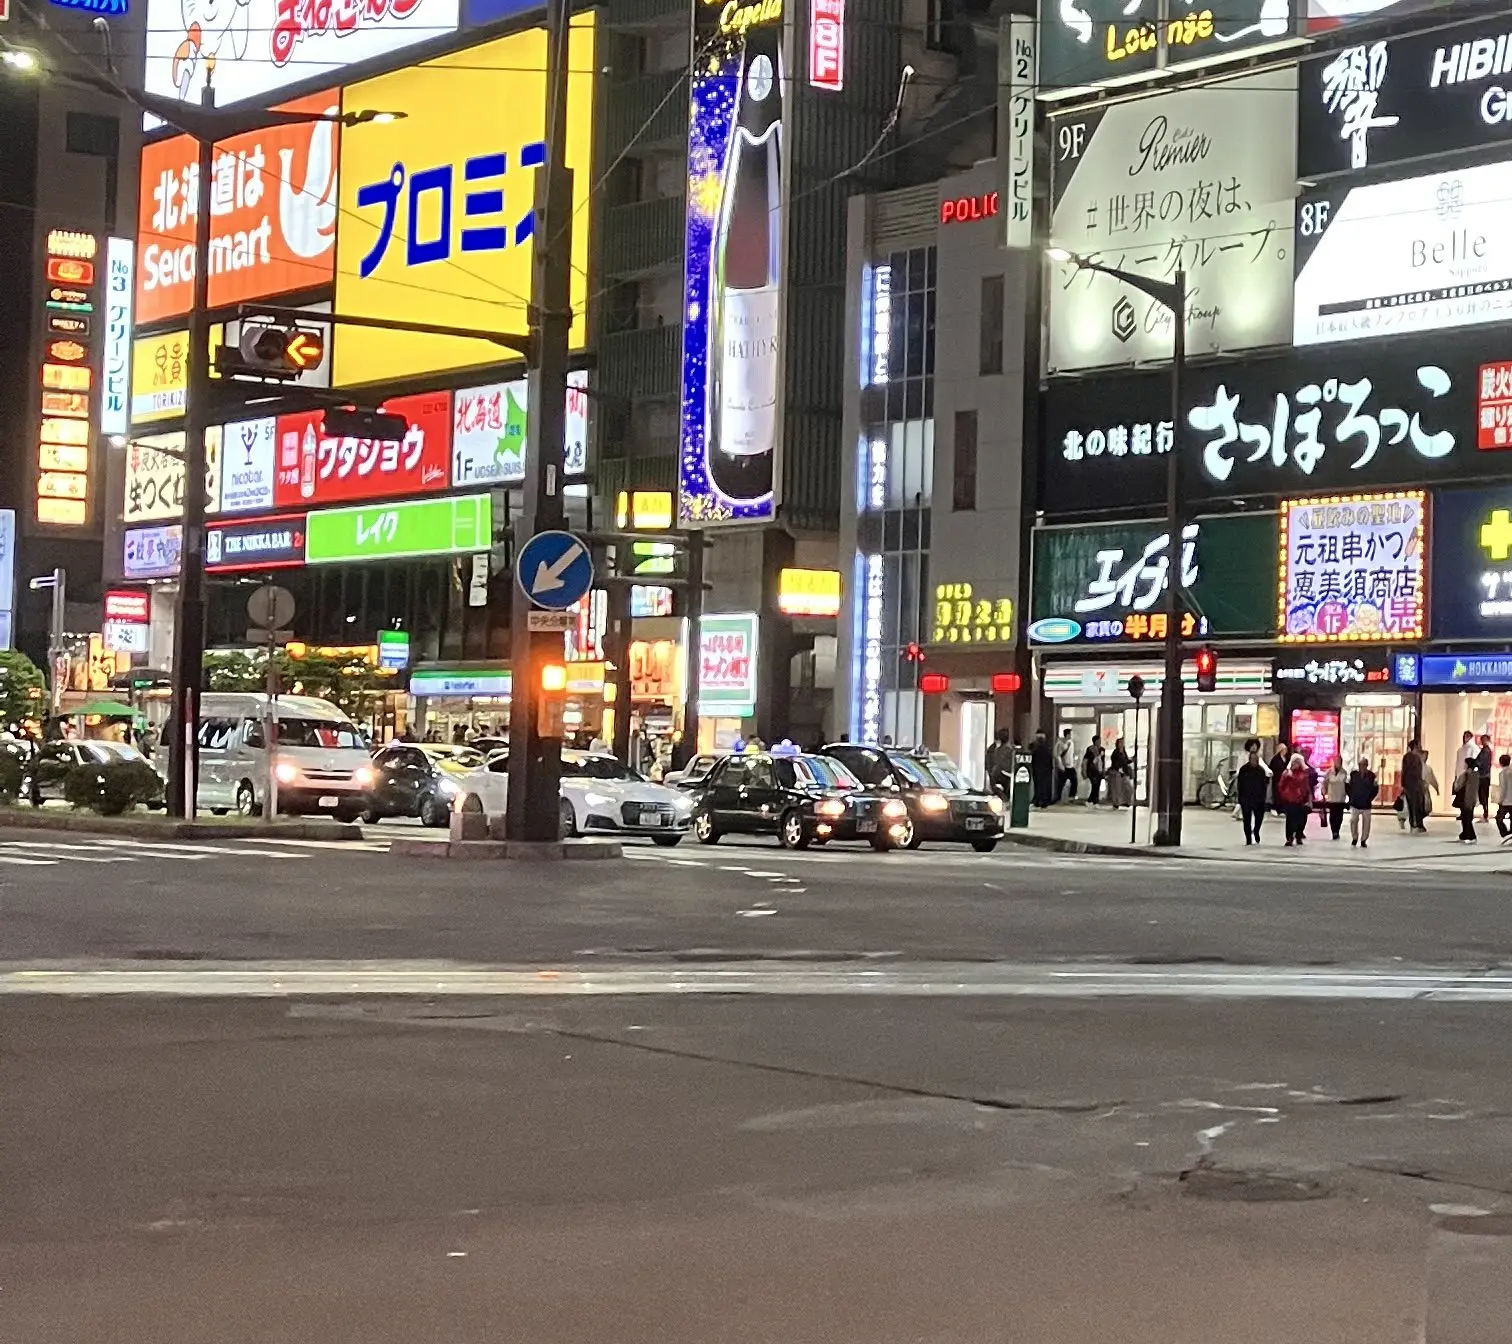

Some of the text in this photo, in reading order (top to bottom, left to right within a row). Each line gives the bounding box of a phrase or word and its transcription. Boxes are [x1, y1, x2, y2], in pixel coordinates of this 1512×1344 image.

[1106, 9, 1214, 61] Lounge
[1017, 58, 1028, 79] 2
[1059, 123, 1086, 161] 9F
[1300, 201, 1330, 236] 8F
[1411, 228, 1488, 268] Belle
[112, 276, 126, 292] 3
[152, 389, 187, 410] TORIKIZ
[1188, 365, 1456, 481] さっぽろっこ
[318, 423, 425, 479] ワタショウ
[1062, 421, 1174, 461] 北の味紀行
[456, 451, 474, 481] 1F
[356, 511, 399, 545] レイク
[1294, 530, 1404, 565] 元祖串かつ
[1292, 566, 1417, 602] 恵美須商店
[1324, 615, 1342, 633] 1F
[1015, 754, 1033, 765] TAXI
